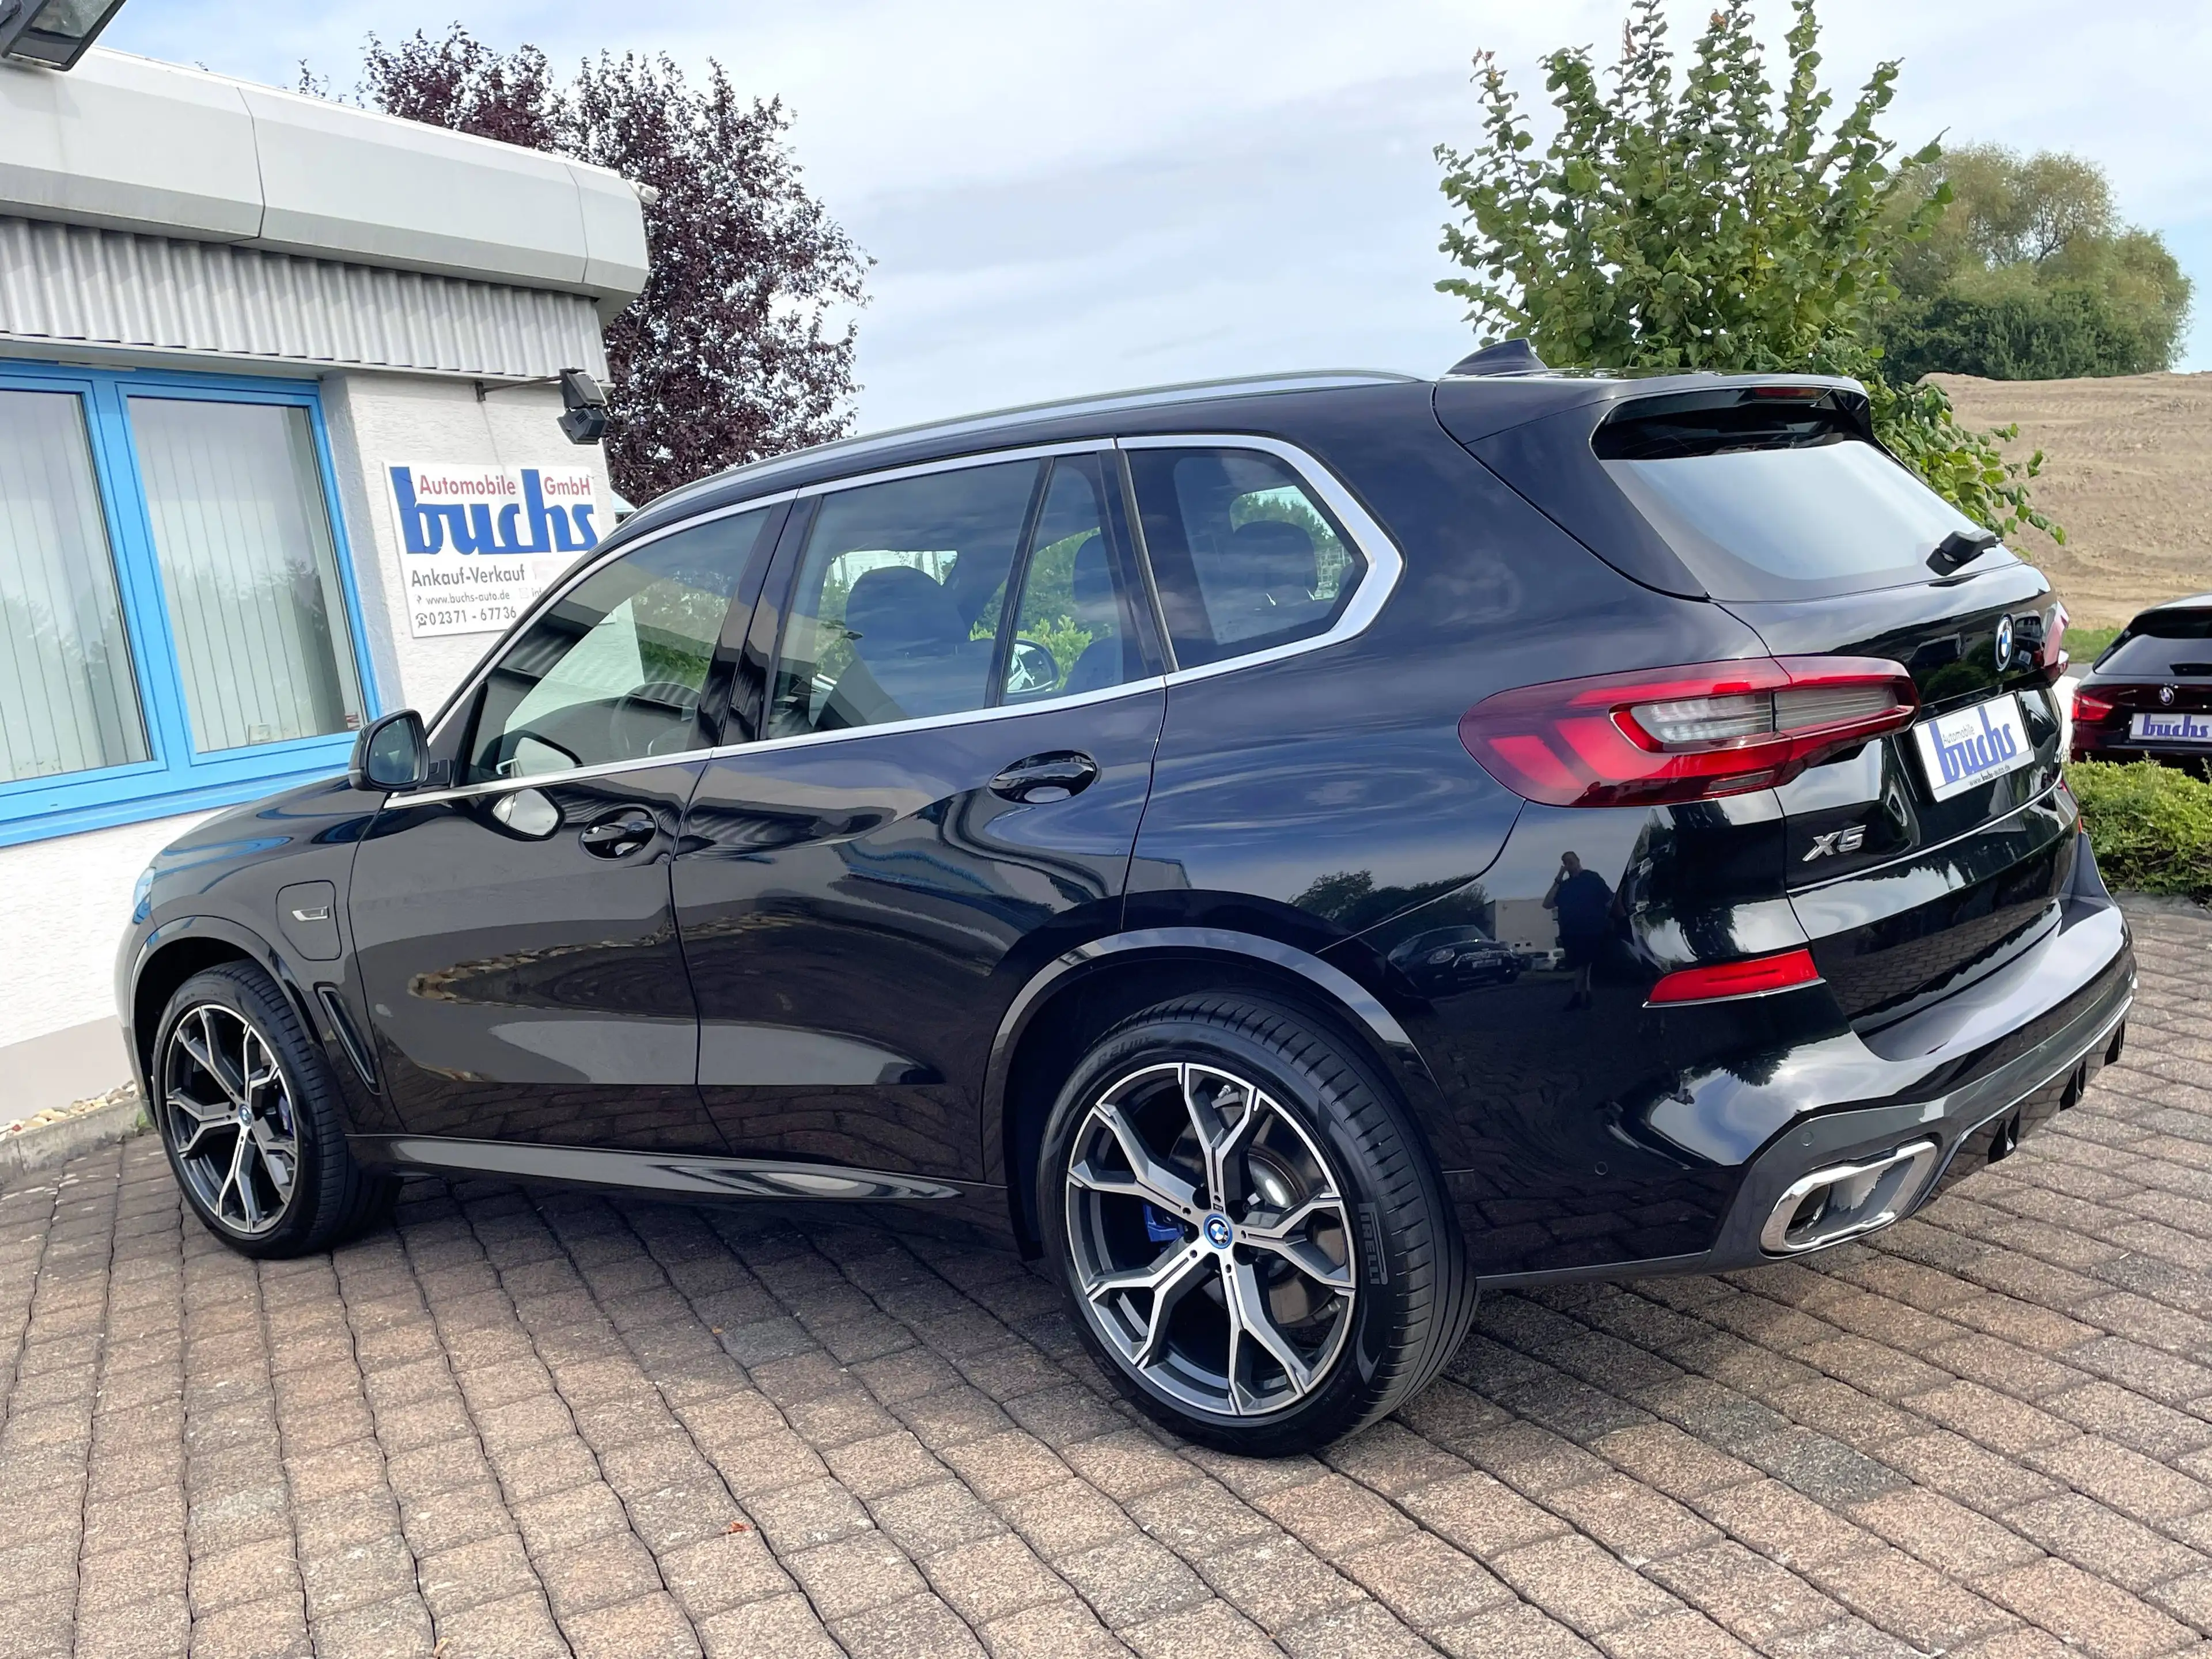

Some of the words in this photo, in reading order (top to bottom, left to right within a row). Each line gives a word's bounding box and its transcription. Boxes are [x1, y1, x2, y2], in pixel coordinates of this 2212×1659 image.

[419, 474, 516, 495] Automobile
[543, 476, 591, 495] GmbH
[389, 466, 599, 555] buchs
[411, 563, 525, 587] Ankauf-Verkauf
[426, 589, 510, 605] www.buchs-auto.de
[429, 609, 467, 625] 02371
[480, 606, 517, 621] 67736
[1942, 724, 1975, 745] Automobile
[2142, 714, 2209, 738] buchs
[1928, 705, 2017, 784] buchs
[1802, 824, 1867, 862] X5
